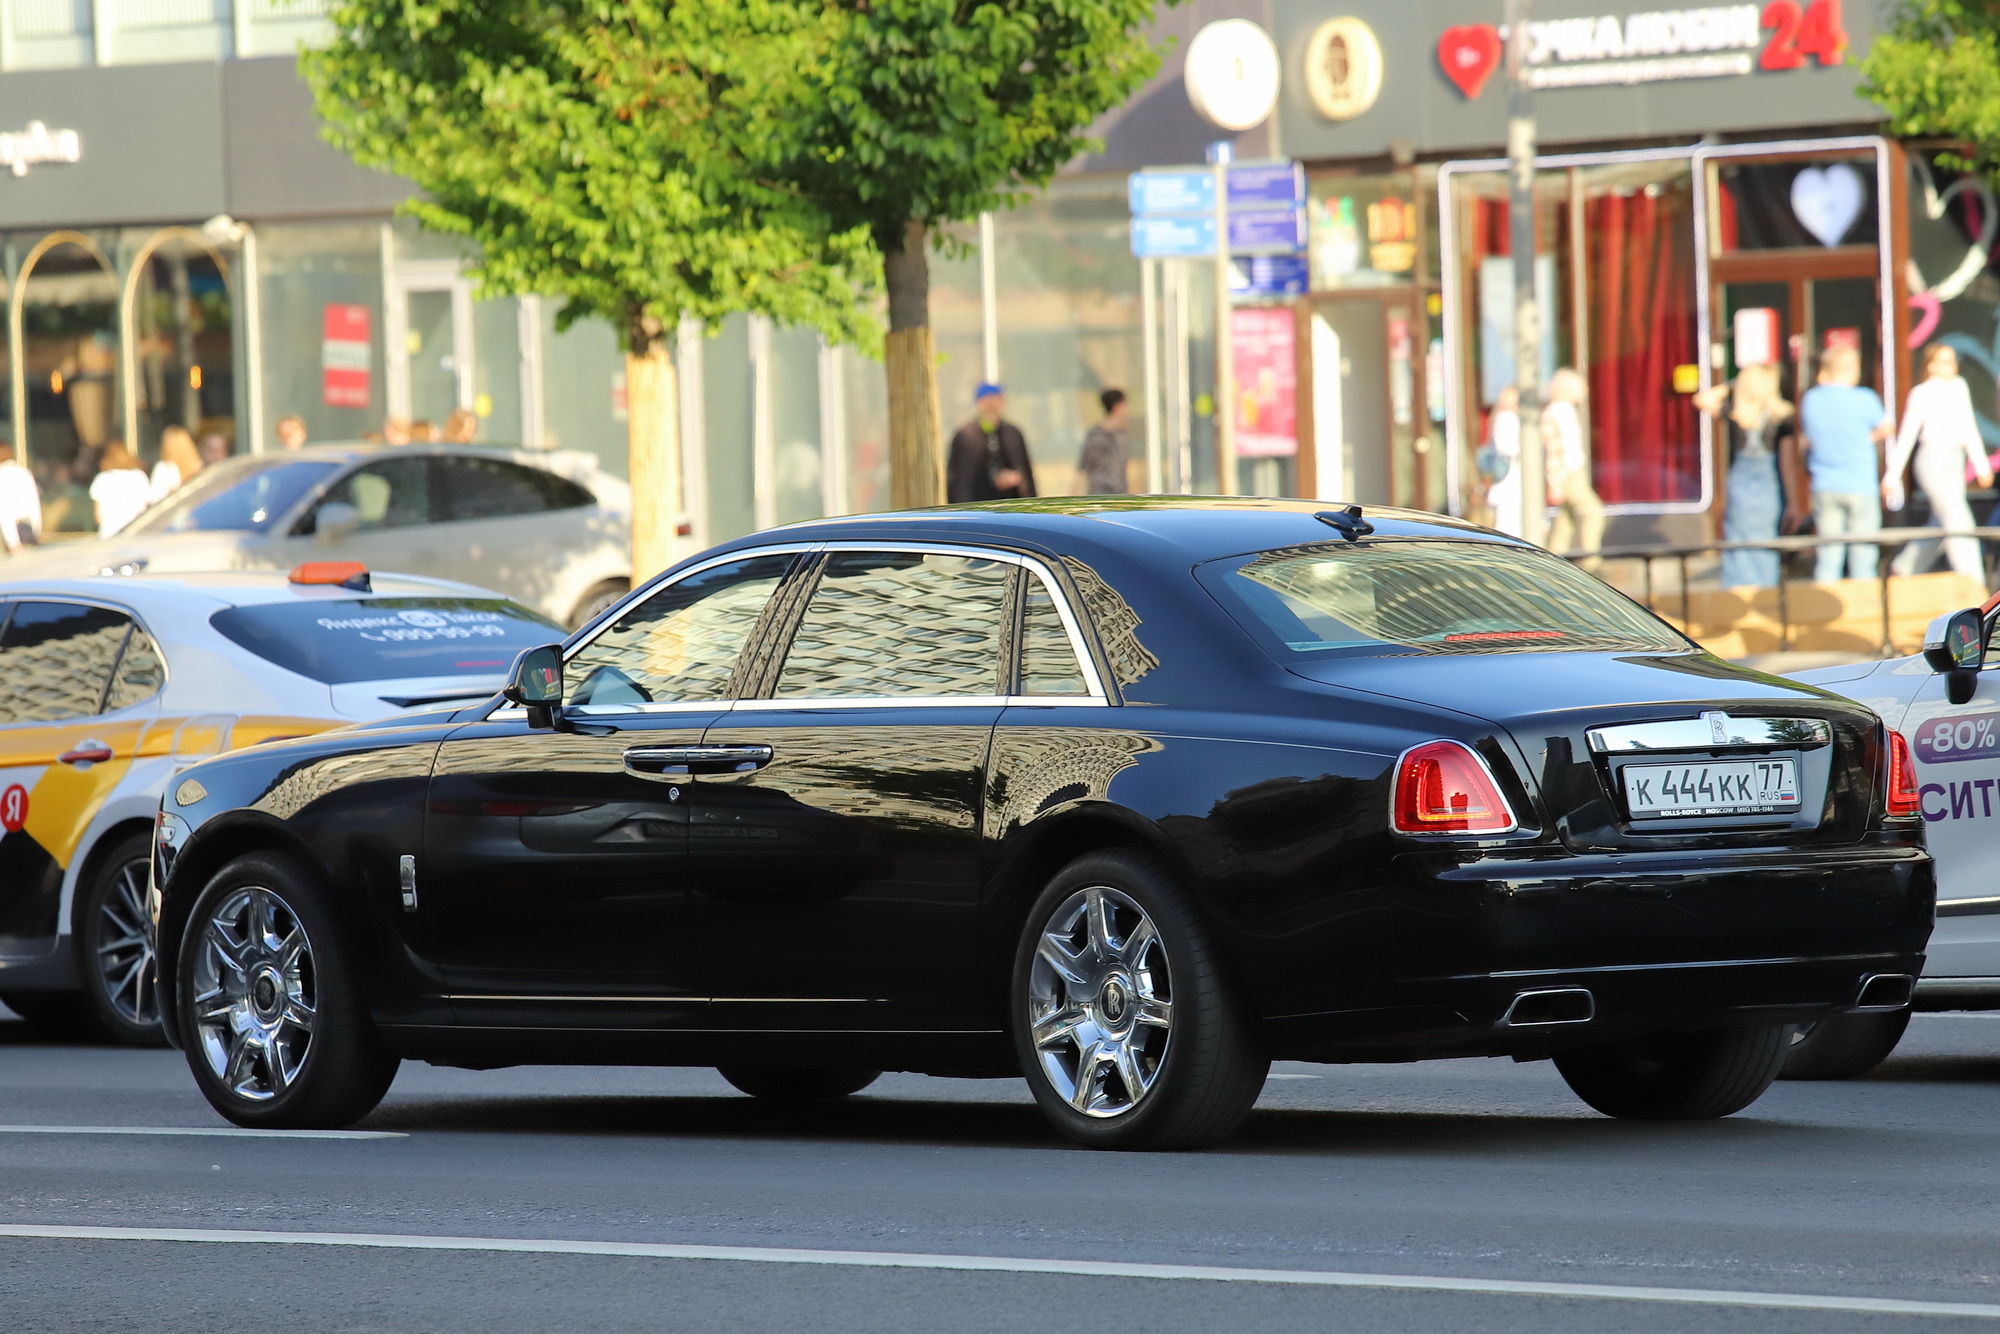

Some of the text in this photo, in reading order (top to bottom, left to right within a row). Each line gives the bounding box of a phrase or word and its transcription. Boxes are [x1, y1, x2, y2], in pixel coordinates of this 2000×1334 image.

[1760, 0, 1848, 70] 24
[317, 611, 503, 630] Яндекс Такси
[382, 624, 505, 640] 999-99-99
[1921, 718, 1996, 752] -80%
[1758, 763, 1783, 790] 77
[6, 789, 21, 822] Я
[1760, 790, 1780, 801] RUS
[1919, 779, 2000, 822] СИТ
[1660, 808, 1702, 817] ROLLS-ROYCE
[1705, 806, 1734, 814] MOSCOW
